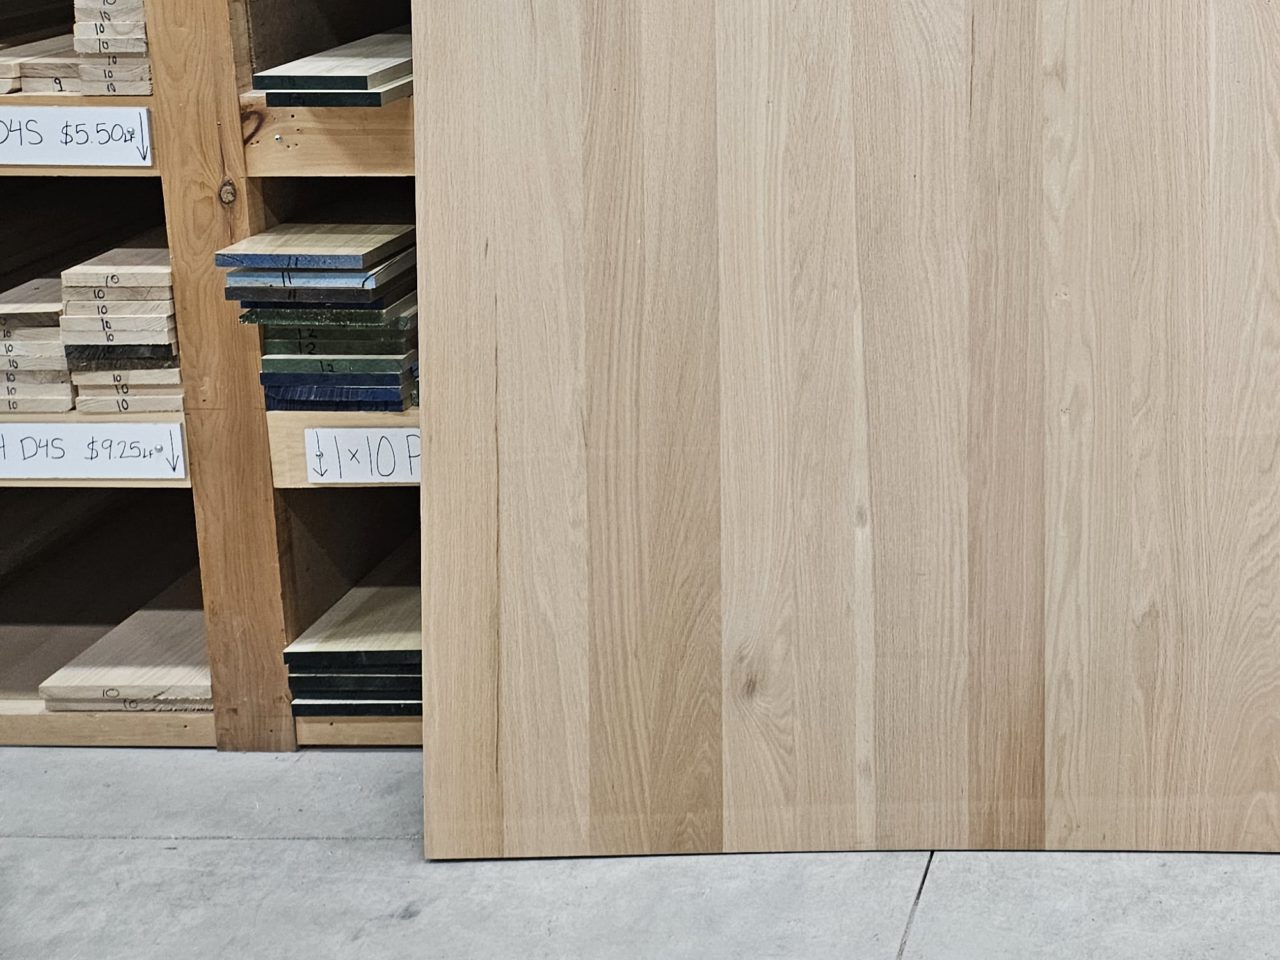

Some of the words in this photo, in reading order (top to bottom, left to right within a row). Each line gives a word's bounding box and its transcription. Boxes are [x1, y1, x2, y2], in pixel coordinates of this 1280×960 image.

[103, 69, 114, 79] 10
[94, 289, 105, 300] 10
[97, 305, 108, 315] 10
[4, 343, 14, 353] 10
[8, 358, 19, 369] 10
[113, 374, 122, 382] 10
[8, 400, 18, 410] 10
[117, 398, 129, 412] 10
[333, 434, 397, 479] 1x10
